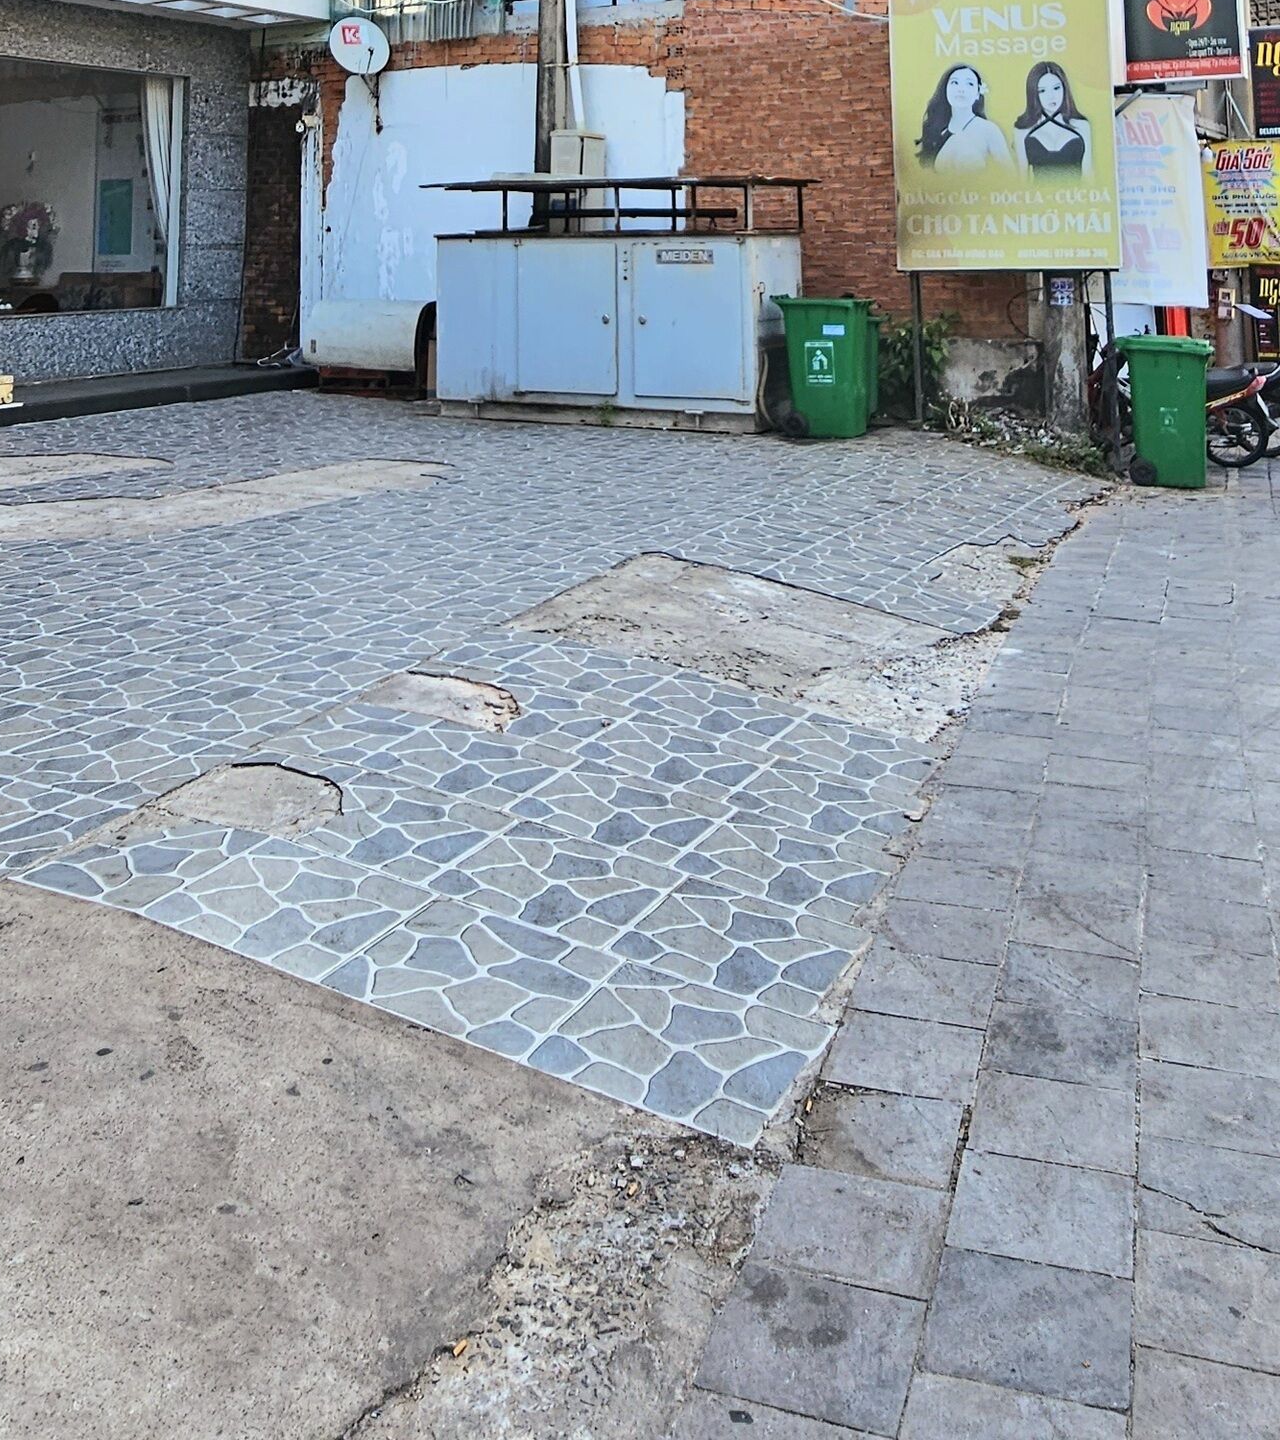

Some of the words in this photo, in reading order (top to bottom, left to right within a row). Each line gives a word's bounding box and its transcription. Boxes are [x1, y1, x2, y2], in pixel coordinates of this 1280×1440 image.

[932, 2, 1067, 33] VENUS
[934, 34, 1067, 58] Massage
[907, 214, 962, 234] CHO
[969, 214, 998, 234] TA
[661, 250, 708, 261] MEIDEN
